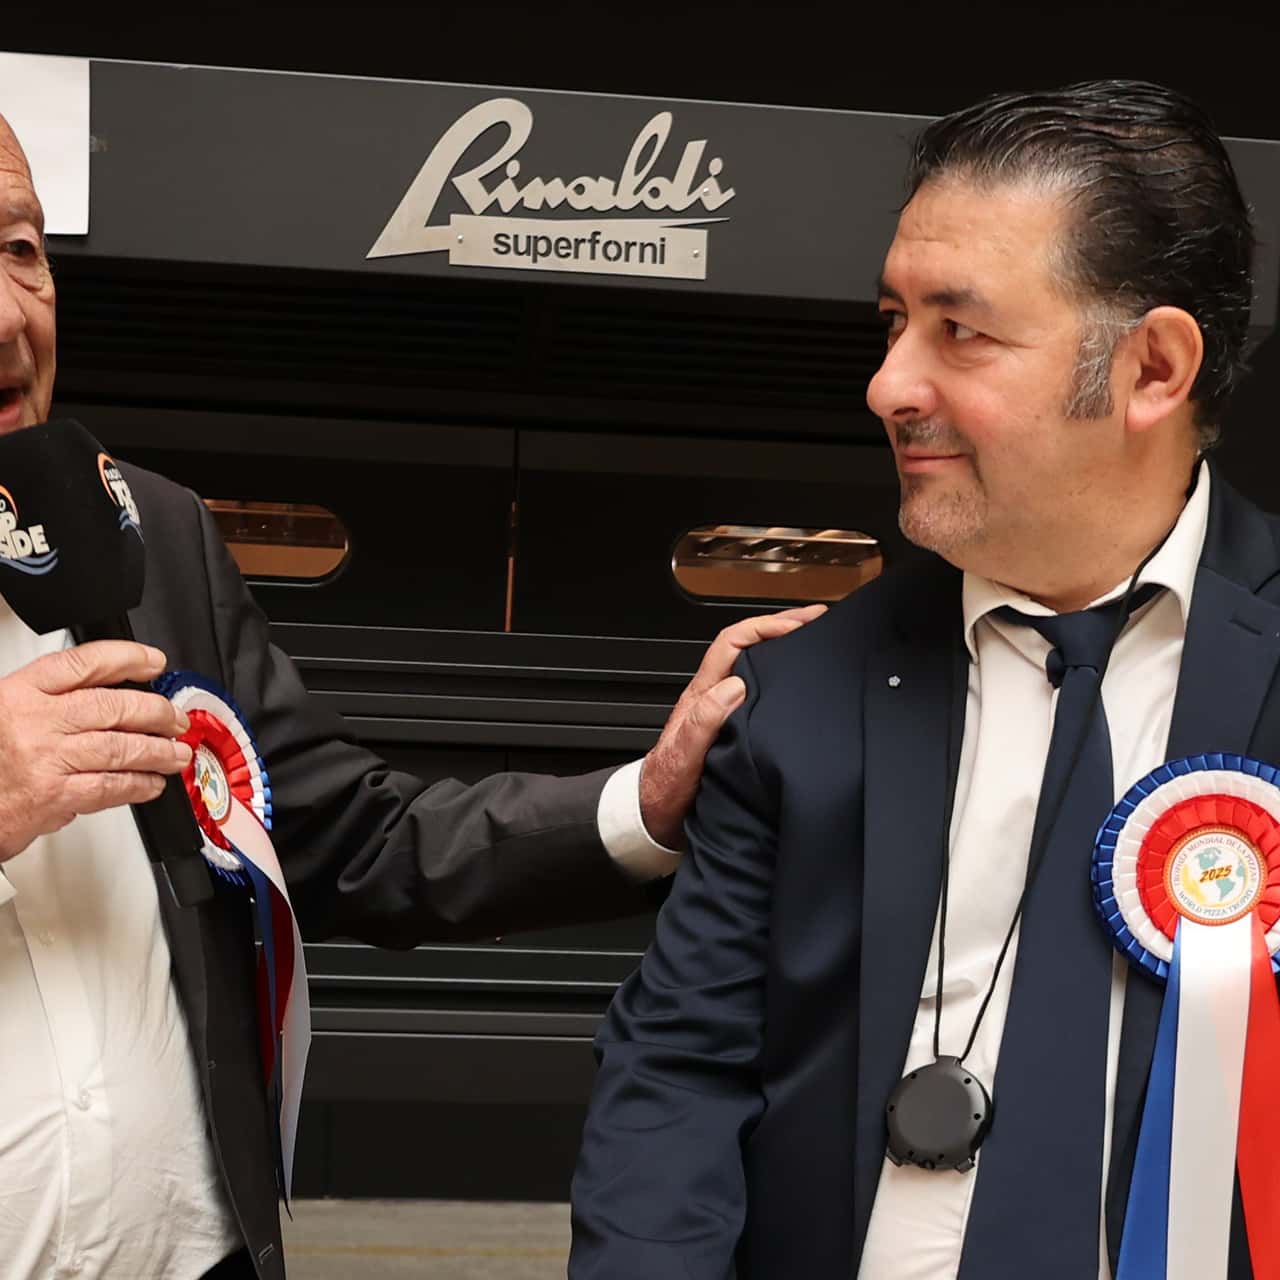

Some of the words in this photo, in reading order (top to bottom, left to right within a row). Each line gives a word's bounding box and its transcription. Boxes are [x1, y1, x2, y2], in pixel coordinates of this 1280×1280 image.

[366, 98, 736, 259] Rinaldi
[493, 230, 667, 265] superforni
[1199, 865, 1233, 883] 2025
